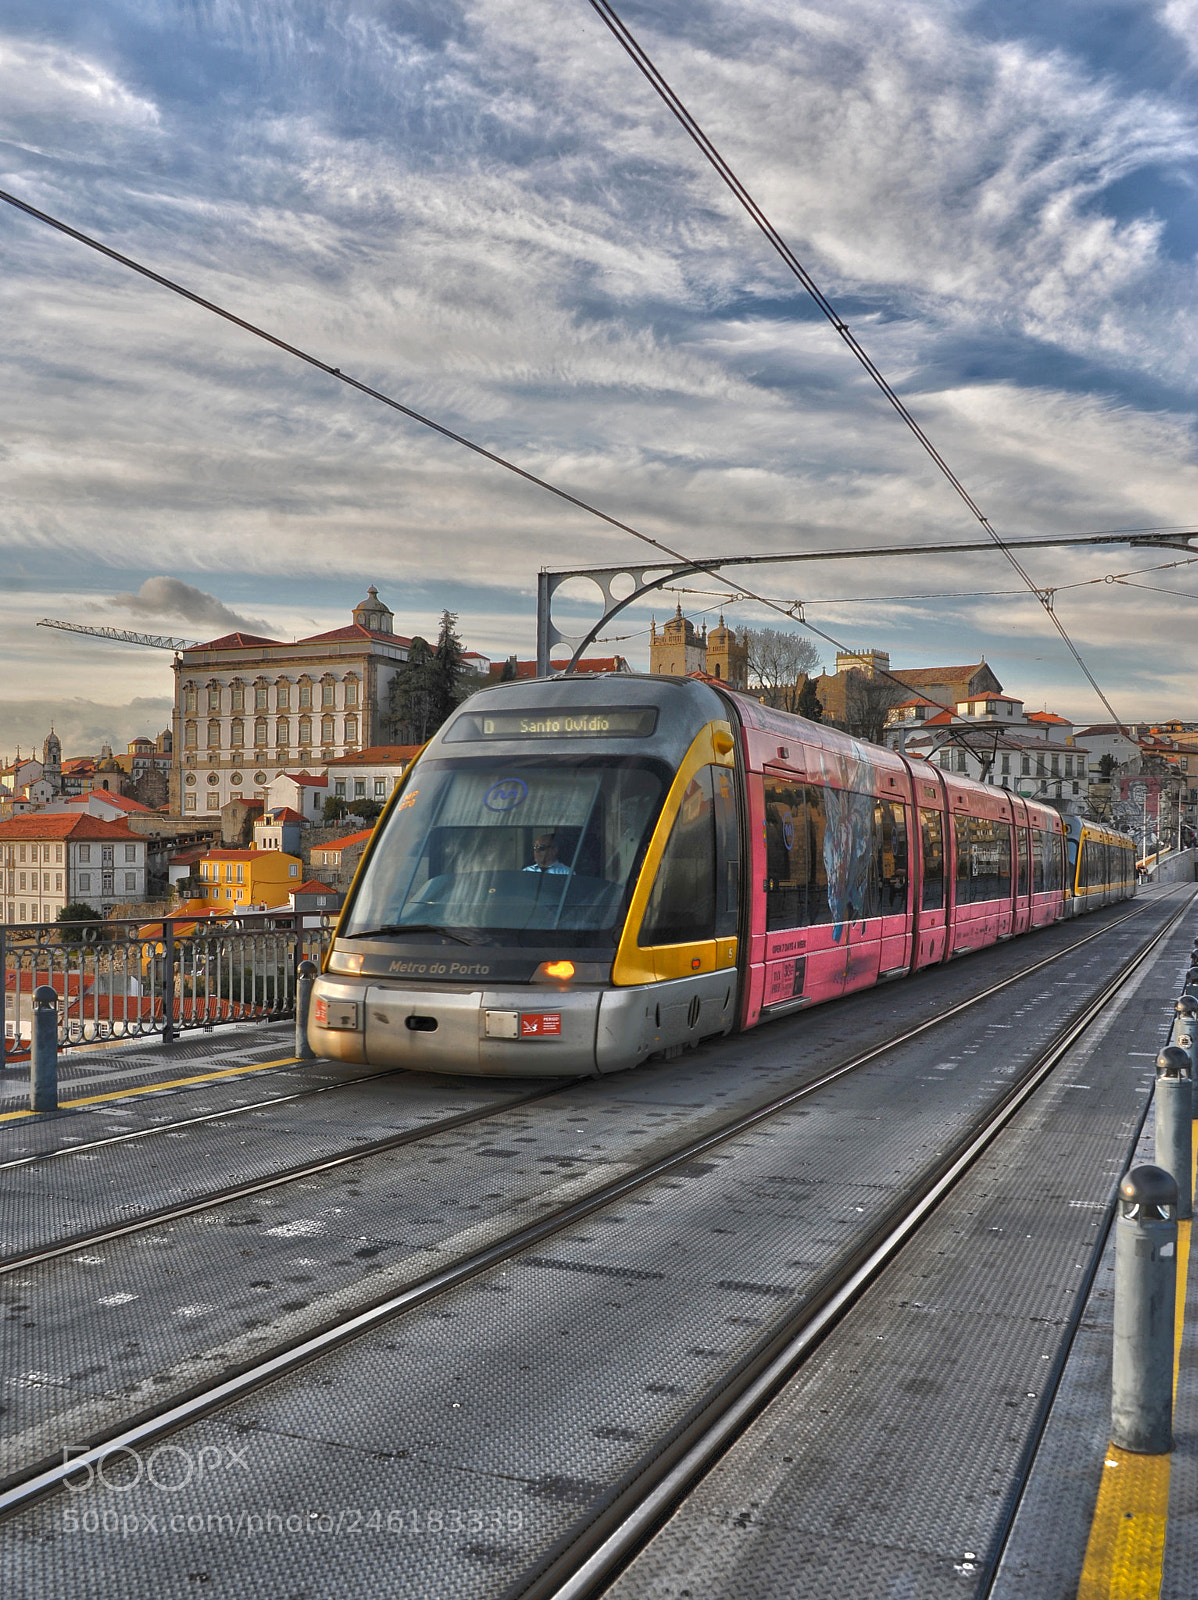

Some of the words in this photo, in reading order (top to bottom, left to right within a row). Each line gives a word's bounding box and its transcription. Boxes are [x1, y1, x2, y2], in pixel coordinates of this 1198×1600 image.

[520, 718, 560, 733] Santo
[388, 960, 427, 973] Metro
[429, 962, 447, 974] do
[449, 962, 490, 975] Porto
